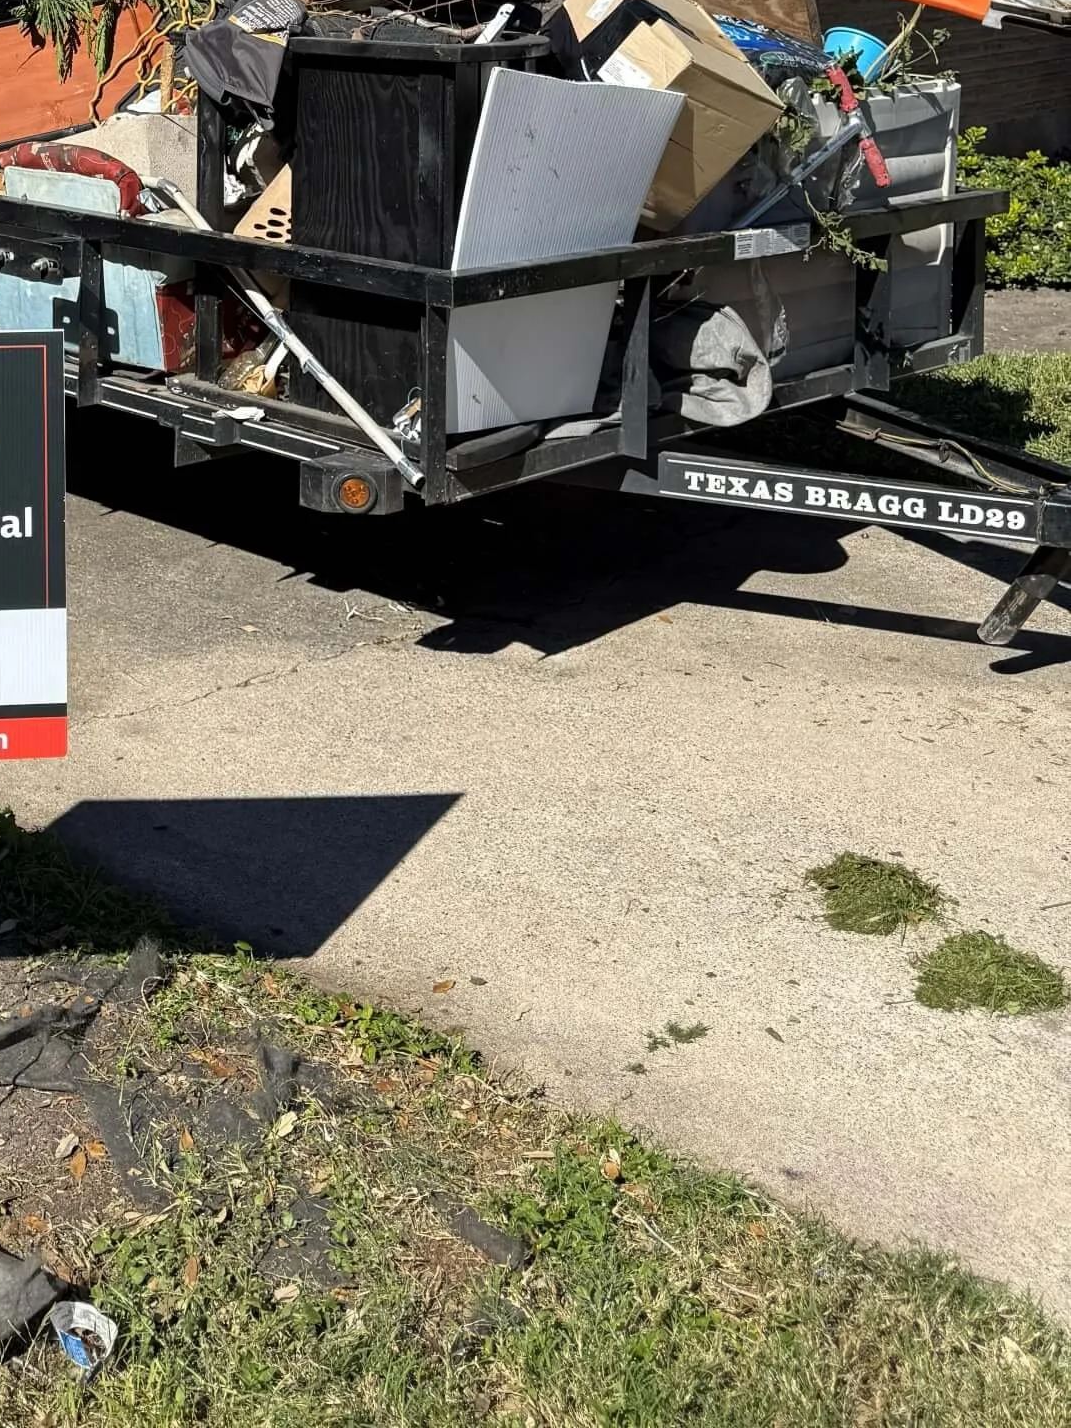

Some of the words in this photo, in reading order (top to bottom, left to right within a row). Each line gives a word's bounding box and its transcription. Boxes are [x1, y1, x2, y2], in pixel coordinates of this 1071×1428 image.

[684, 471, 794, 503] TEXAS
[805, 485, 927, 519] BRAGG
[938, 502, 1026, 530] LD29
